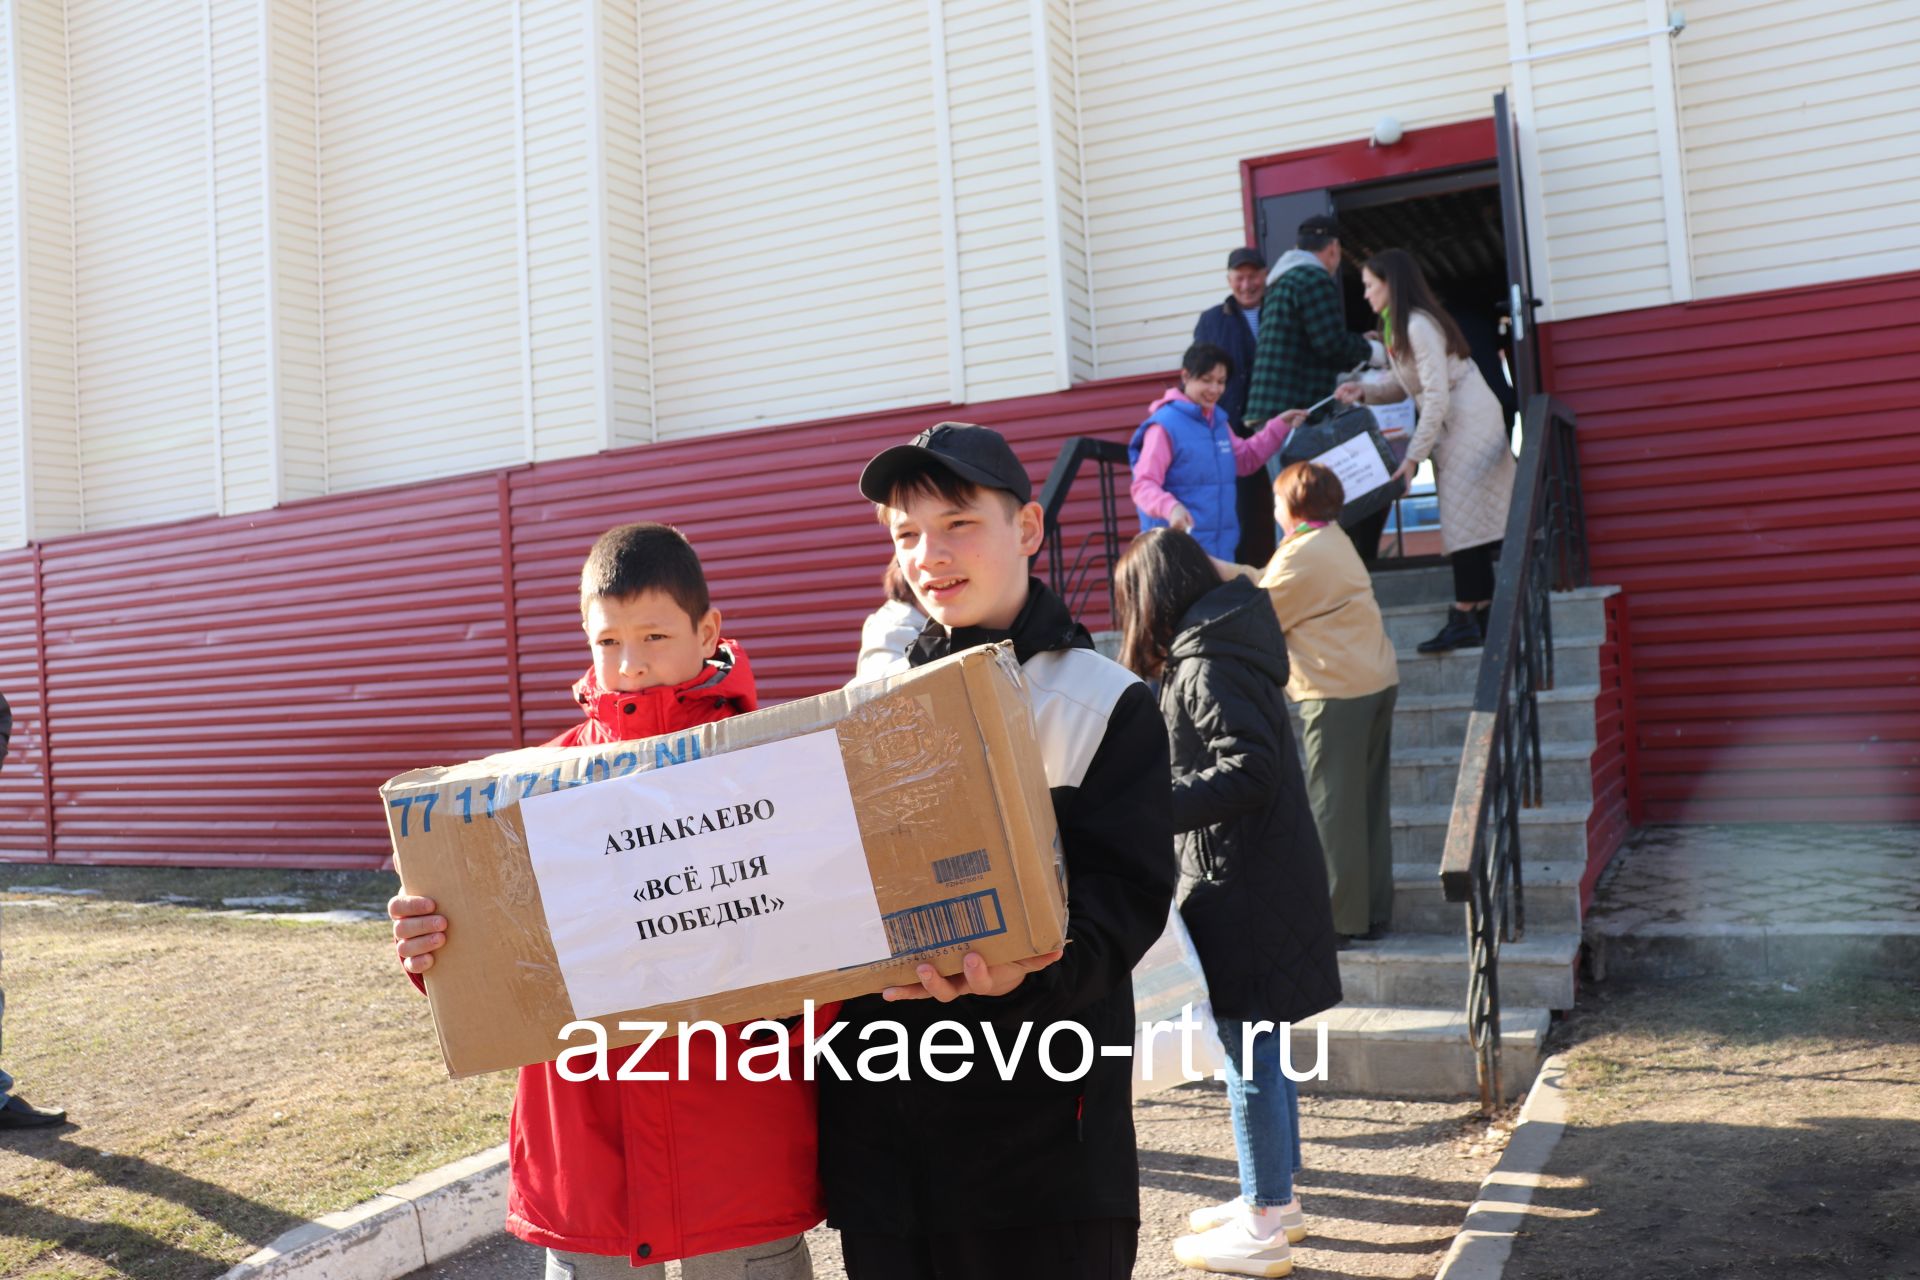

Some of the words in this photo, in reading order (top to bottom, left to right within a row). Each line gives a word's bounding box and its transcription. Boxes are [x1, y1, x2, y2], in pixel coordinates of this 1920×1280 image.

[390, 792, 439, 837] 77
[455, 781, 497, 824] 11
[515, 751, 638, 799] 71-02
[604, 798, 775, 856] АЗНАКАЕВО
[633, 865, 703, 903] «ВСЁ
[710, 854, 770, 891] ДЛЯ
[635, 893, 785, 941] ПОБЕДЫ!»
